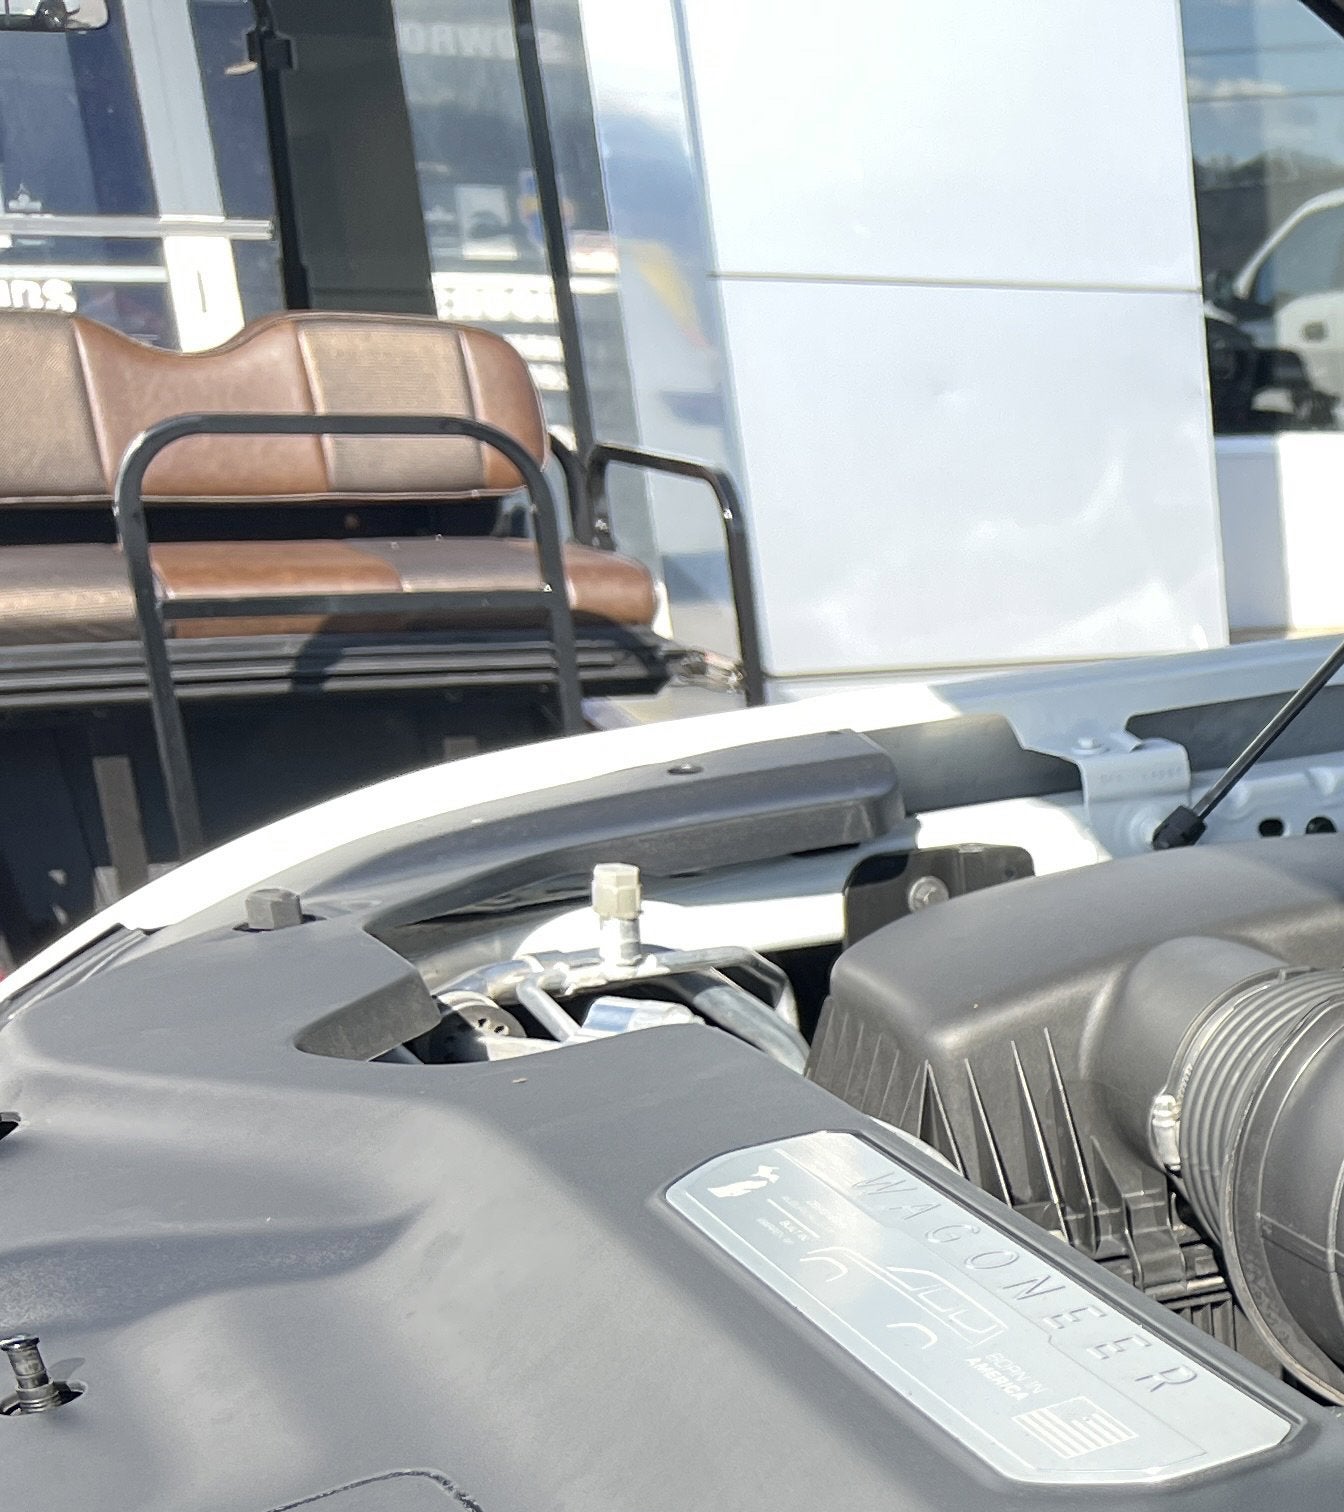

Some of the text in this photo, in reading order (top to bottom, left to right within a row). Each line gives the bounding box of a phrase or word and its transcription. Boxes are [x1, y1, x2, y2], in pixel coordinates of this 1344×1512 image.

[850, 1171, 1198, 1392] WAGONEER
[963, 1357, 1030, 1401] AMERICA
[983, 1351, 1033, 1381] BORN
